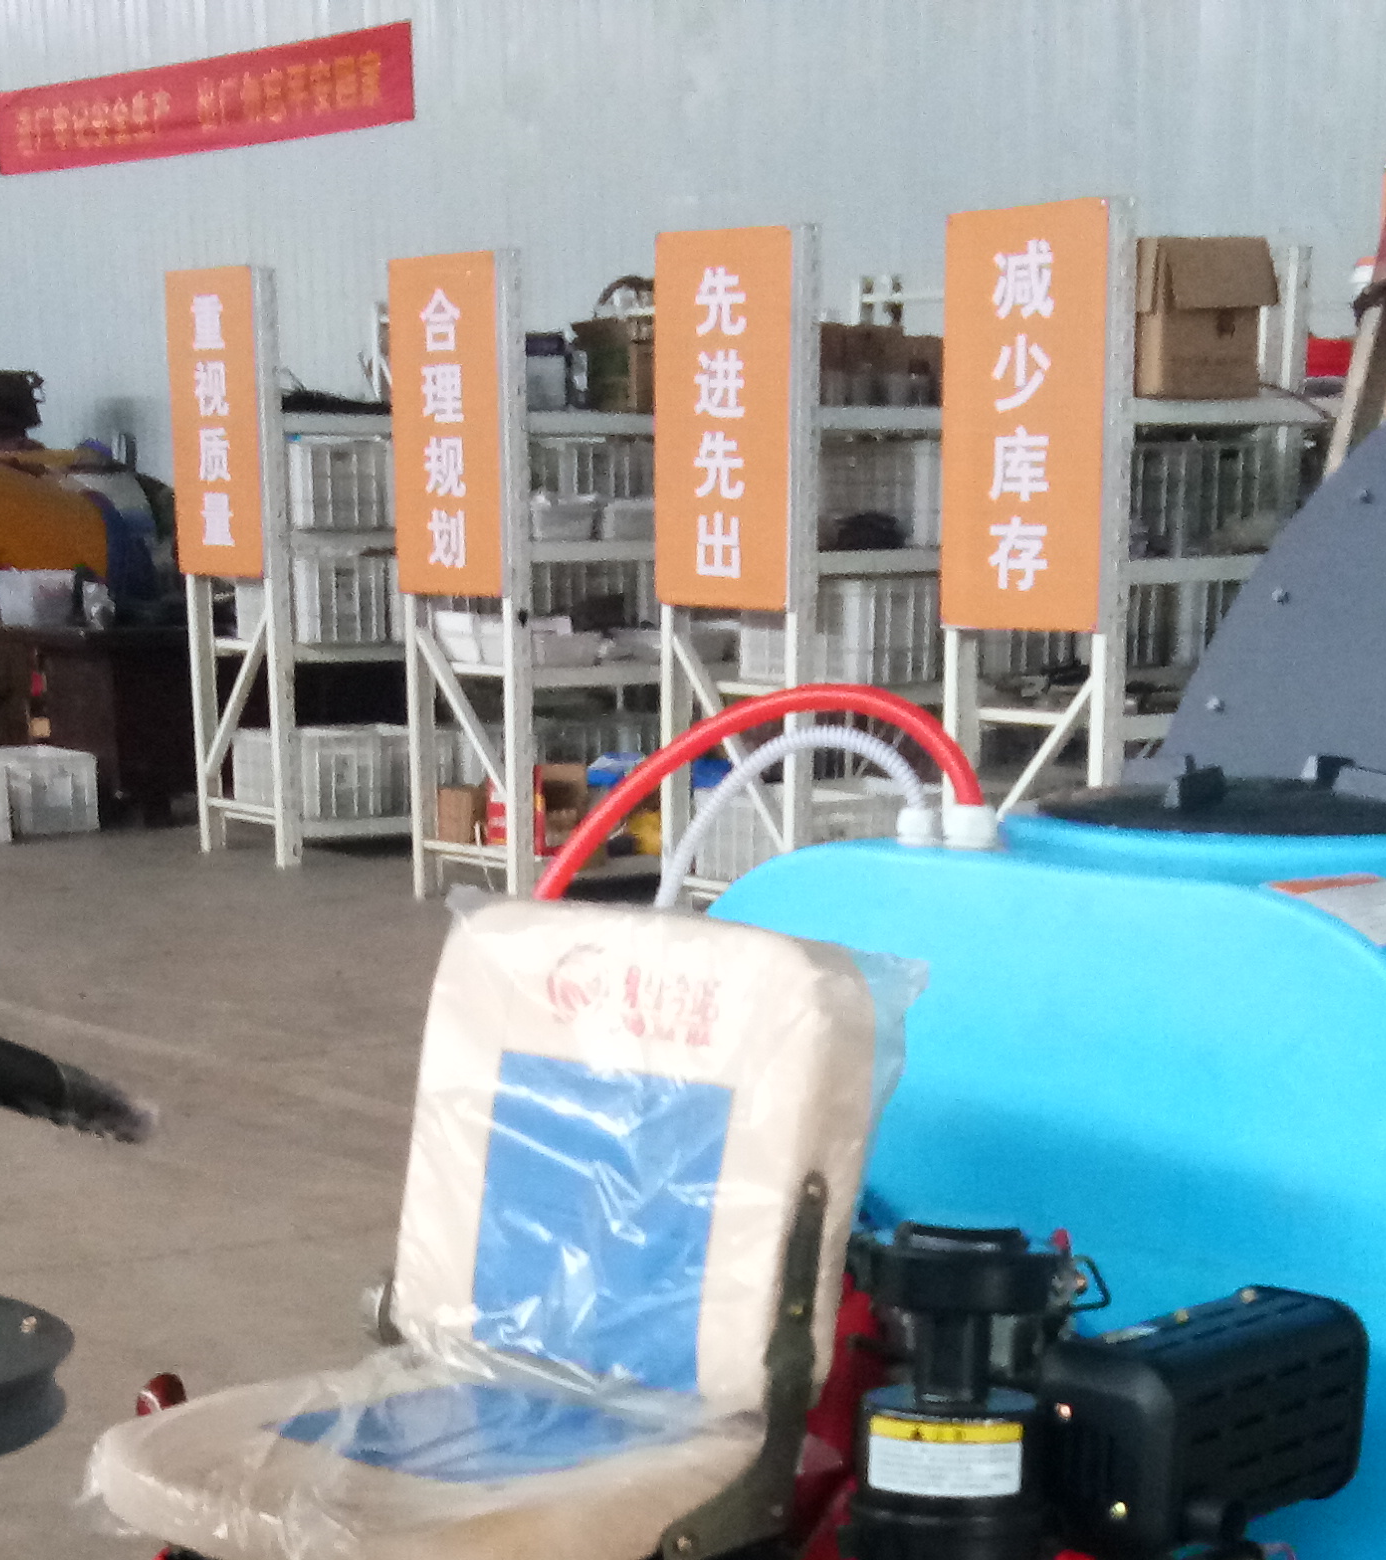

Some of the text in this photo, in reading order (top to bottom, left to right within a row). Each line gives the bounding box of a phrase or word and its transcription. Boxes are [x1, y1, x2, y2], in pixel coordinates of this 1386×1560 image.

[419, 288, 467, 569] 合理规划
[693, 266, 747, 580] 先进先出
[988, 238, 1055, 592] 减少库存
